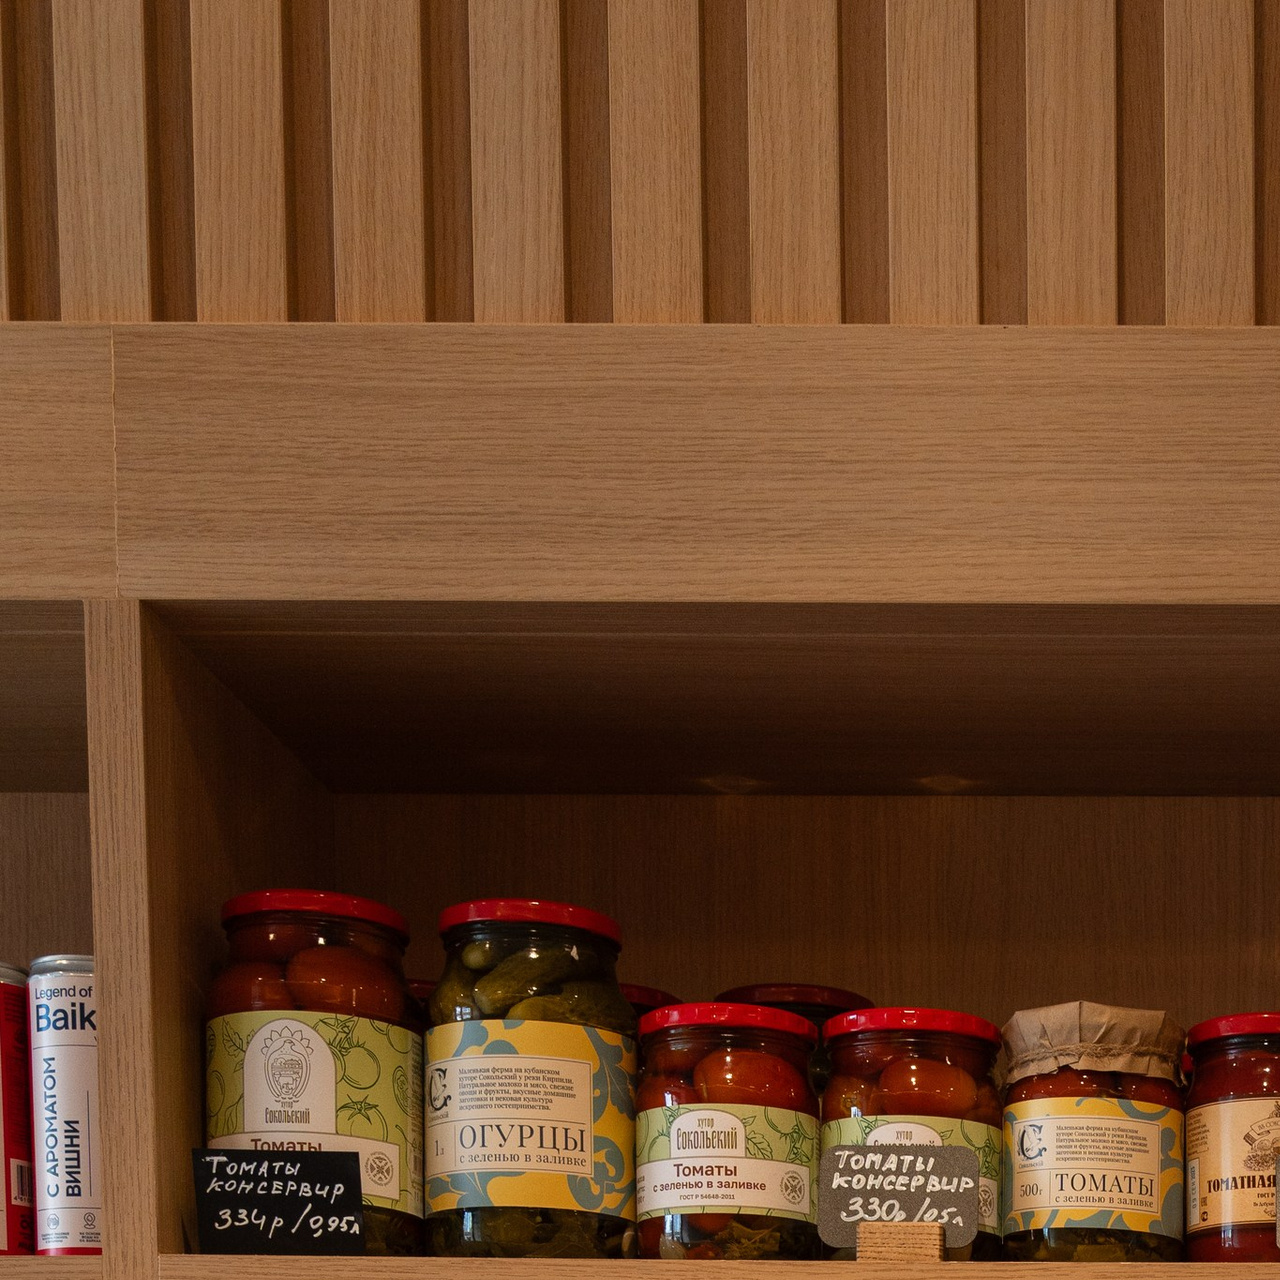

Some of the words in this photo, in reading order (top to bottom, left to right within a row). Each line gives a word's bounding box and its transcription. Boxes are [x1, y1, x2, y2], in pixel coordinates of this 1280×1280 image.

[35, 987, 76, 1000] Legend
[79, 986, 93, 998] of
[36, 1003, 96, 1032] Baik
[43, 1057, 59, 1177] АРОМАТОМ
[265, 1108, 310, 1123] Сокольский
[697, 1118, 714, 1128] хутор
[459, 1124, 585, 1154] ОГУРЦЫ
[677, 1127, 737, 1150] Сокольский
[896, 1130, 912, 1141] хутор
[250, 1139, 322, 1151] Томаты
[64, 1119, 81, 1197] ВИШНИ
[460, 1155, 464, 1163] с
[469, 1154, 520, 1163] зеленью
[536, 1155, 586, 1167] заливке
[835, 1151, 935, 1173] ТОМАТЫ
[674, 1164, 737, 1177] Томаты
[660, 1181, 702, 1191] зеленью
[717, 1181, 766, 1190] заливке
[832, 1172, 975, 1192] КОНСЕРВИР
[1055, 1173, 1154, 1196] ТОМАТЫ
[1207, 1175, 1276, 1193] ТОМАТНАЯ
[47, 1184, 59, 1197] С
[1063, 1195, 1105, 1203] зеленью
[1117, 1197, 1153, 1208] заливке
